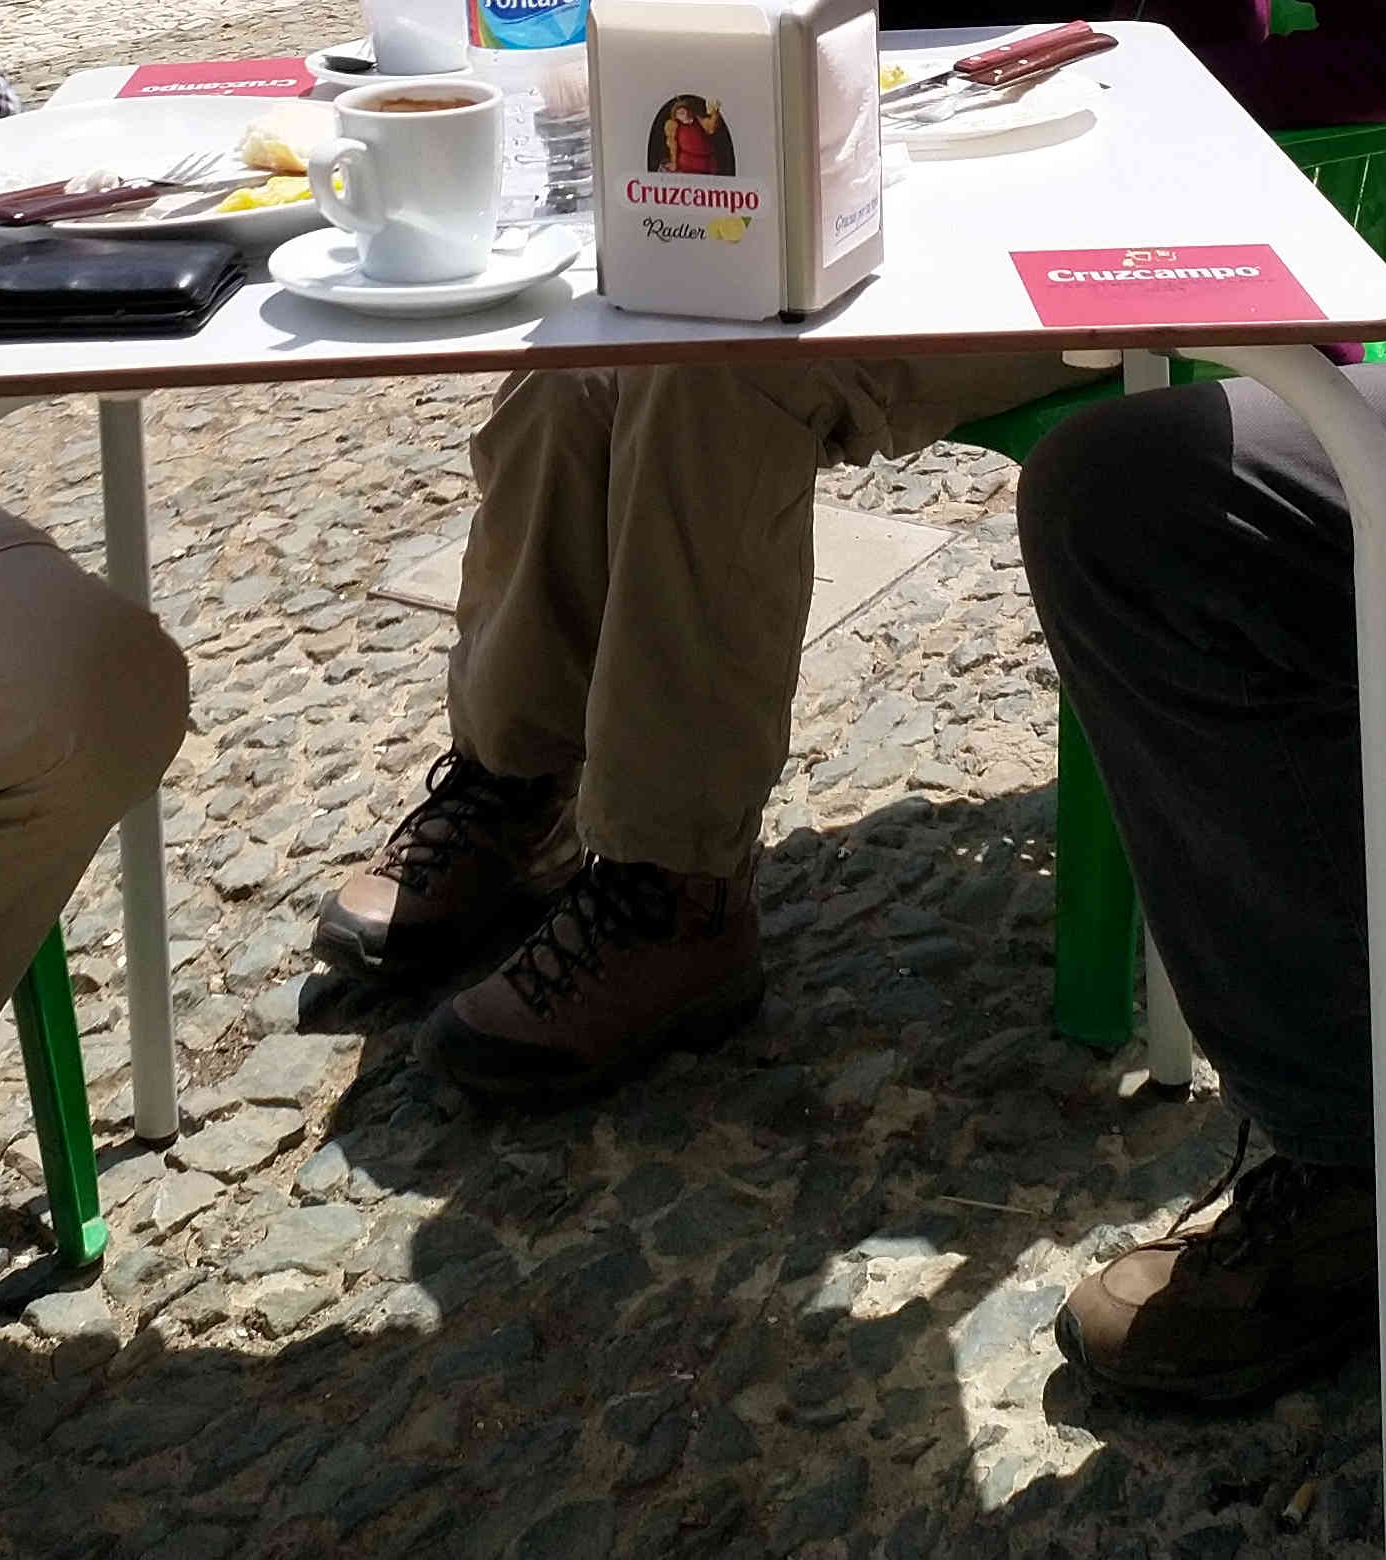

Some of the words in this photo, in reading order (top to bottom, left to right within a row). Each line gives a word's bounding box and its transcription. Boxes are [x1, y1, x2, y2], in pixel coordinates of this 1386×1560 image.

[141, 78, 298, 93] Cruzcampo
[626, 179, 760, 214] Cruzcampo
[643, 216, 707, 243] Radler
[1046, 265, 1262, 283] Cruzcampo
